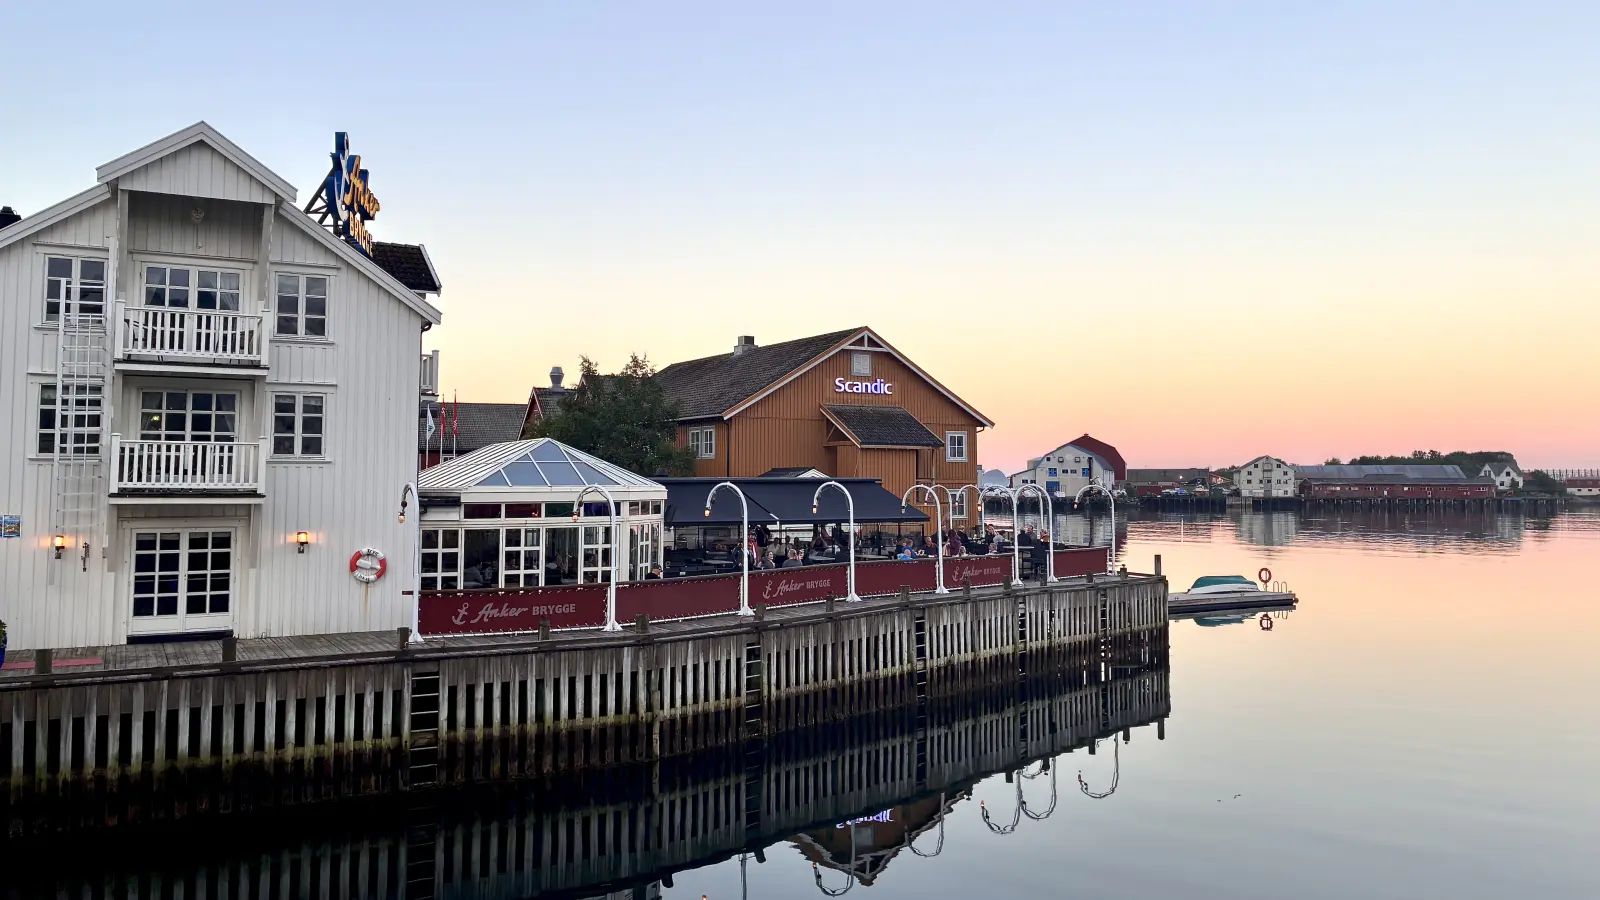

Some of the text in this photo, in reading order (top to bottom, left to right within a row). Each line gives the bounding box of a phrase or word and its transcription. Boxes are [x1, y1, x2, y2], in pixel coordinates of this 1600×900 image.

[344, 155, 380, 216] Anker
[349, 211, 373, 257] BRYGGE
[835, 377, 893, 394] Scandic
[959, 566, 982, 580] Anker
[772, 579, 831, 597] Anker BRYGGE
[470, 602, 576, 624] Anker BRYGGE
